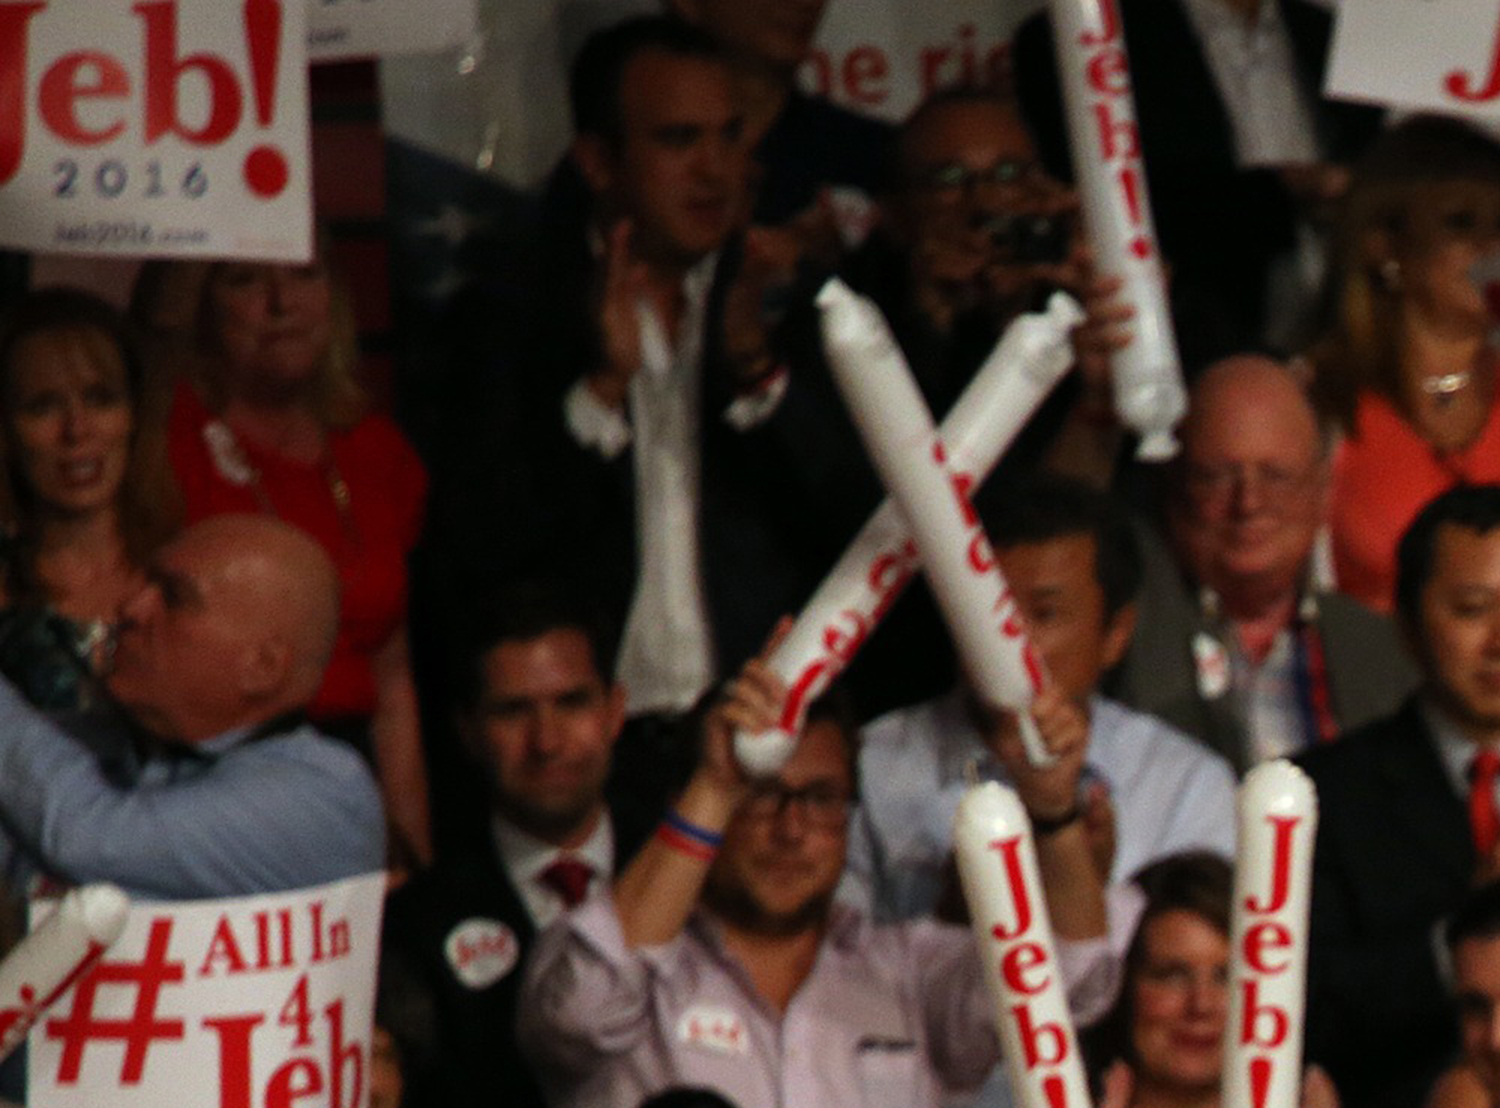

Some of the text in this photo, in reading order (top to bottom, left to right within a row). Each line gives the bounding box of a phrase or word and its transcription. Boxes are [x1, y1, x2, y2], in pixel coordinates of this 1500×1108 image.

[53, 157, 209, 200] 2016
[198, 907, 294, 978] All
[308, 899, 352, 964] In
[277, 972, 313, 1050] 4
